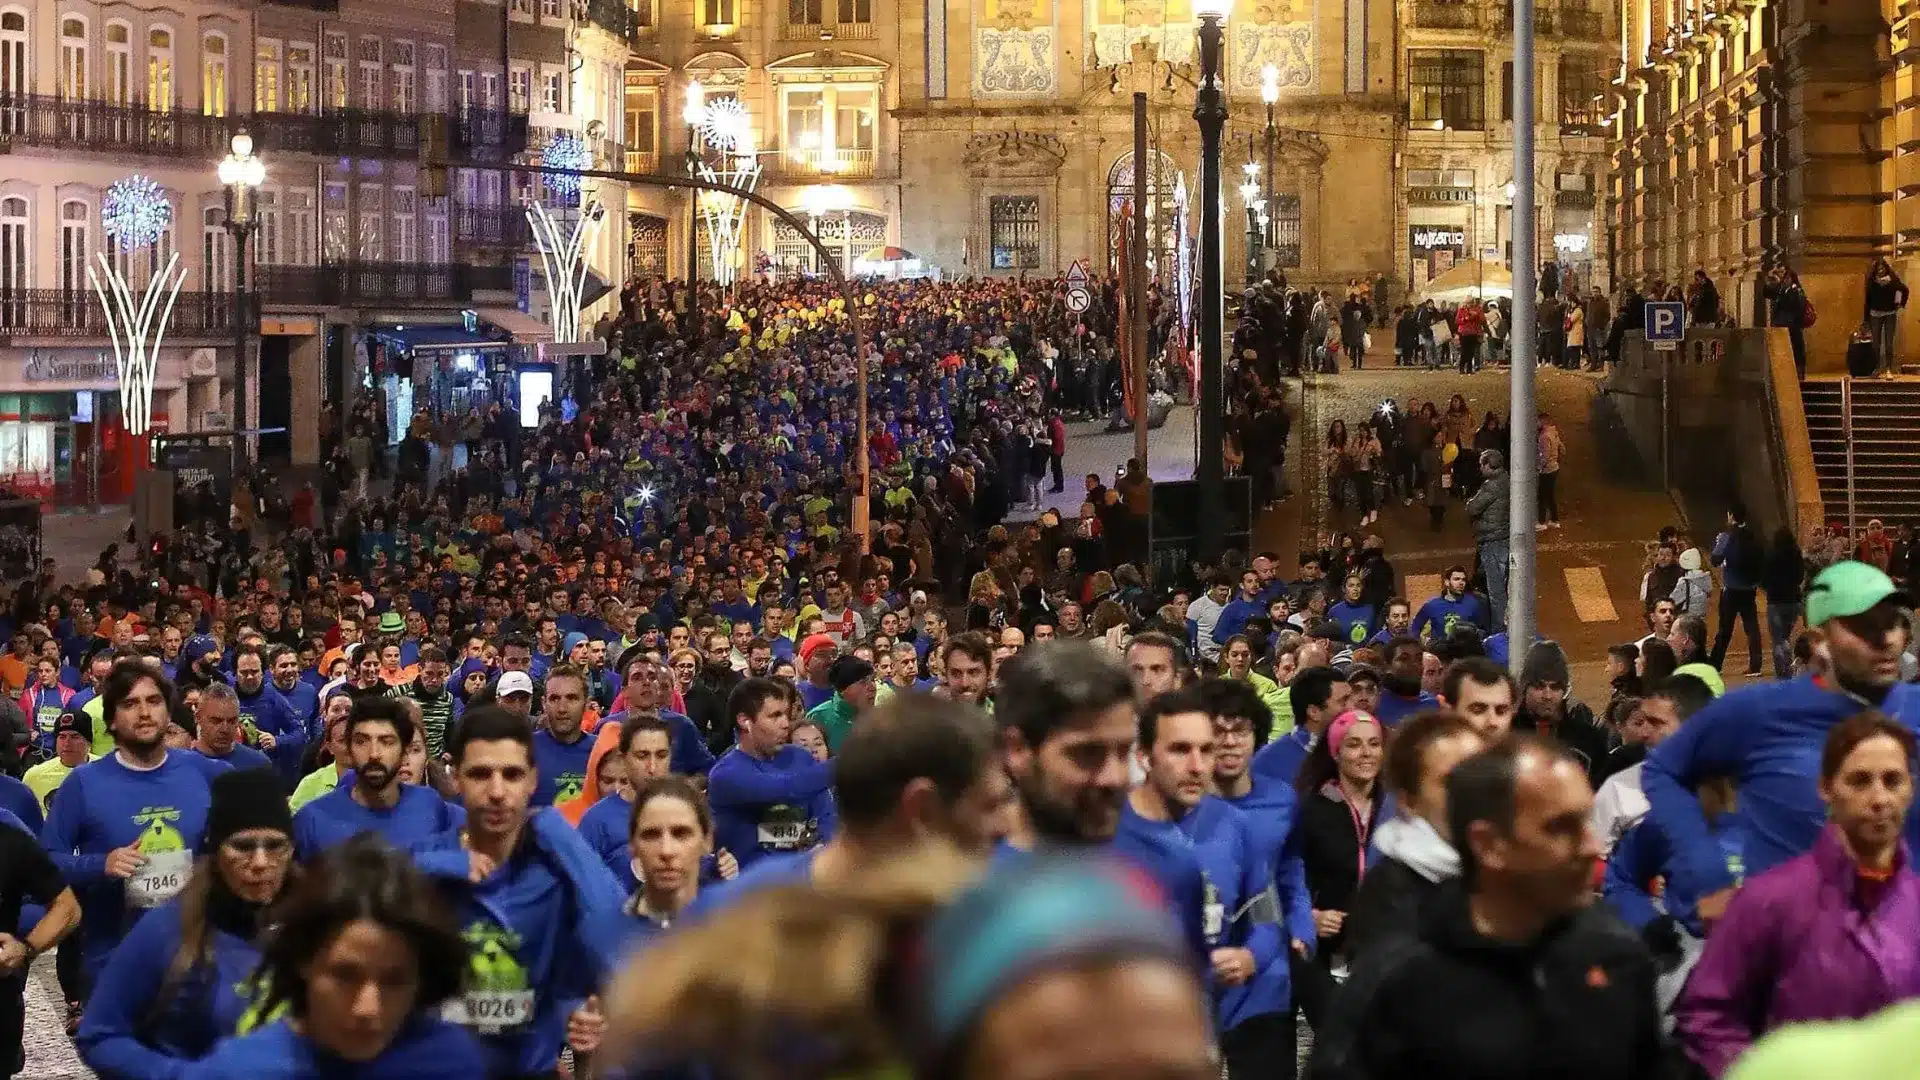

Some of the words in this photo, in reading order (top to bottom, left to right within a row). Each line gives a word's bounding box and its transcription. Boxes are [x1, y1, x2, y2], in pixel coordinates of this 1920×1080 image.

[1412, 190, 1474, 201] VIAGENS
[1655, 309, 1674, 334] P
[143, 874, 178, 891] 7846
